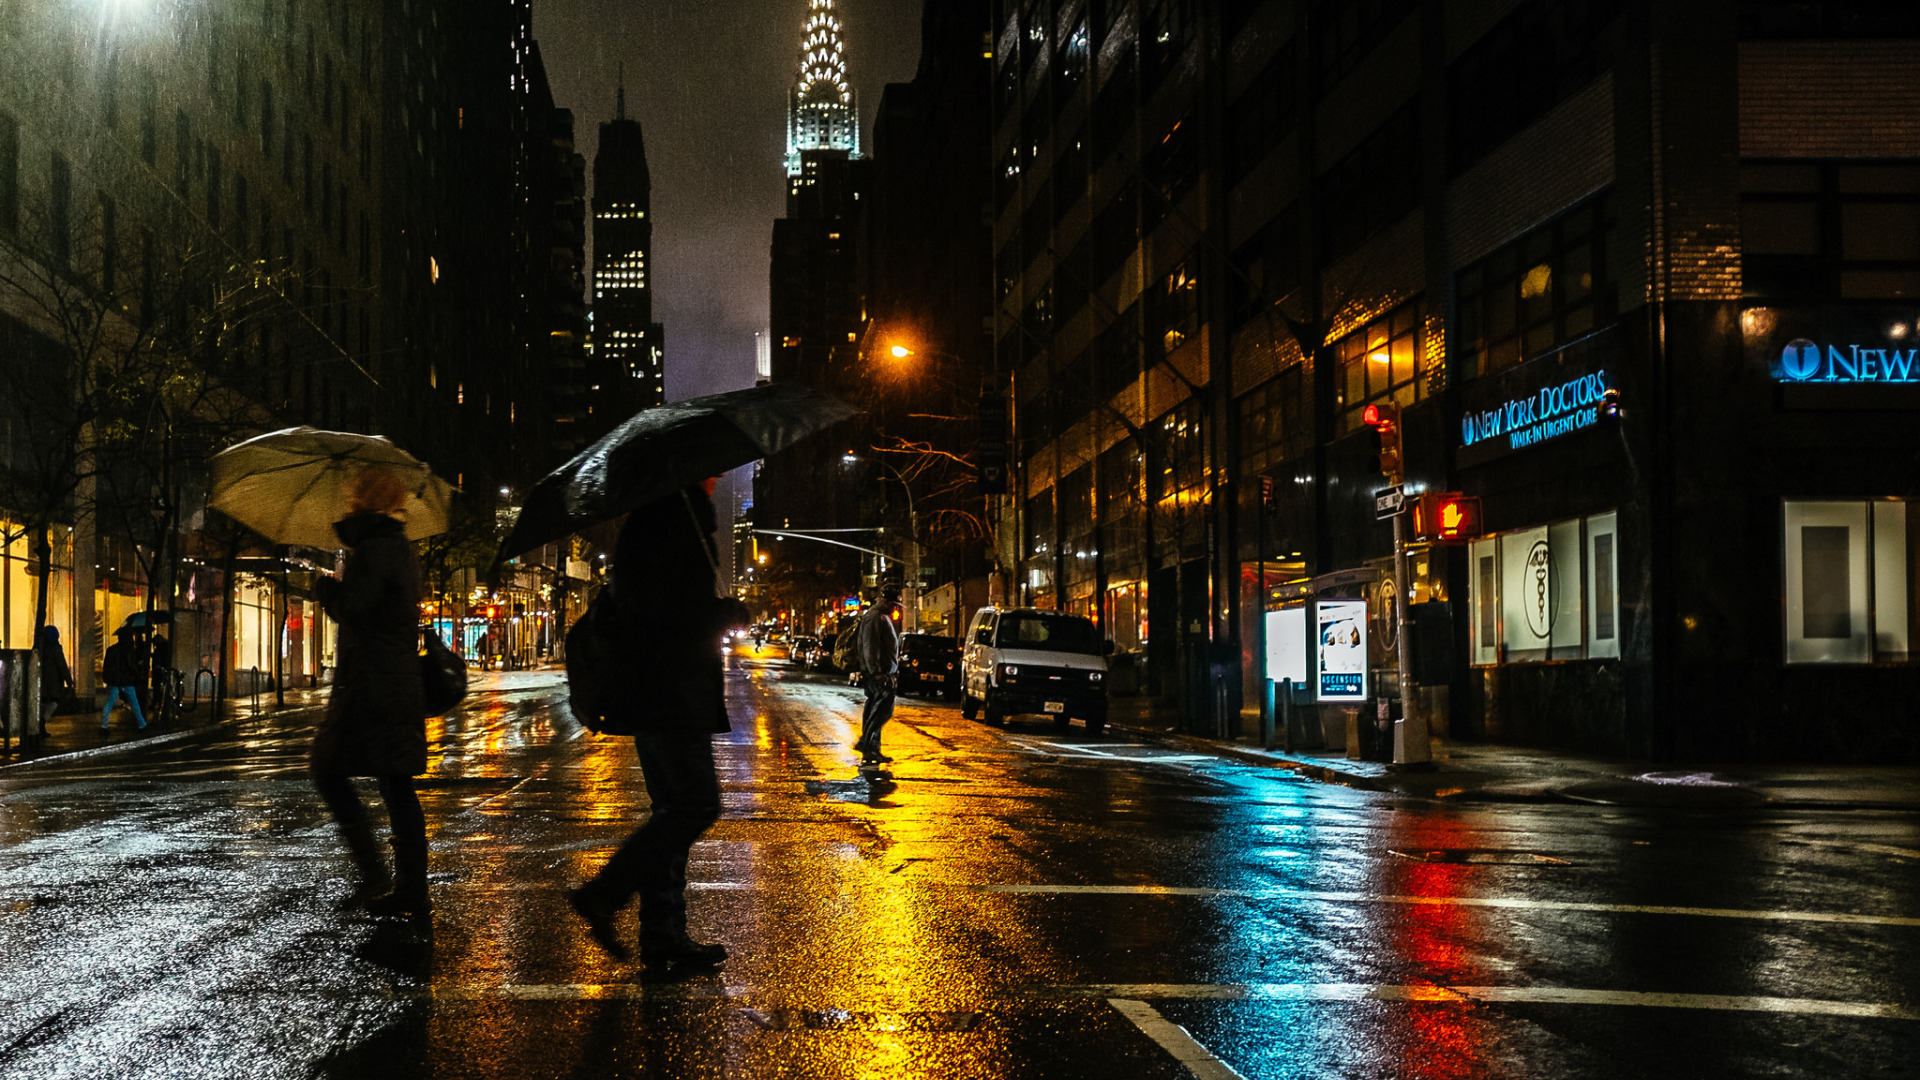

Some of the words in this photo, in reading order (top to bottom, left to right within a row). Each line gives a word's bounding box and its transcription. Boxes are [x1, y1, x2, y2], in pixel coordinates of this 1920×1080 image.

[1826, 345, 1917, 379] NEW
[1475, 409, 1502, 441] NEW
[1504, 396, 1537, 432] YORK
[1540, 369, 1606, 420] DOCTORS
[1511, 426, 1542, 449] WALK-IN
[1543, 416, 1574, 439] URGENT
[1575, 408, 1597, 427] CARE
[1322, 675, 1361, 684] ASCENSION
